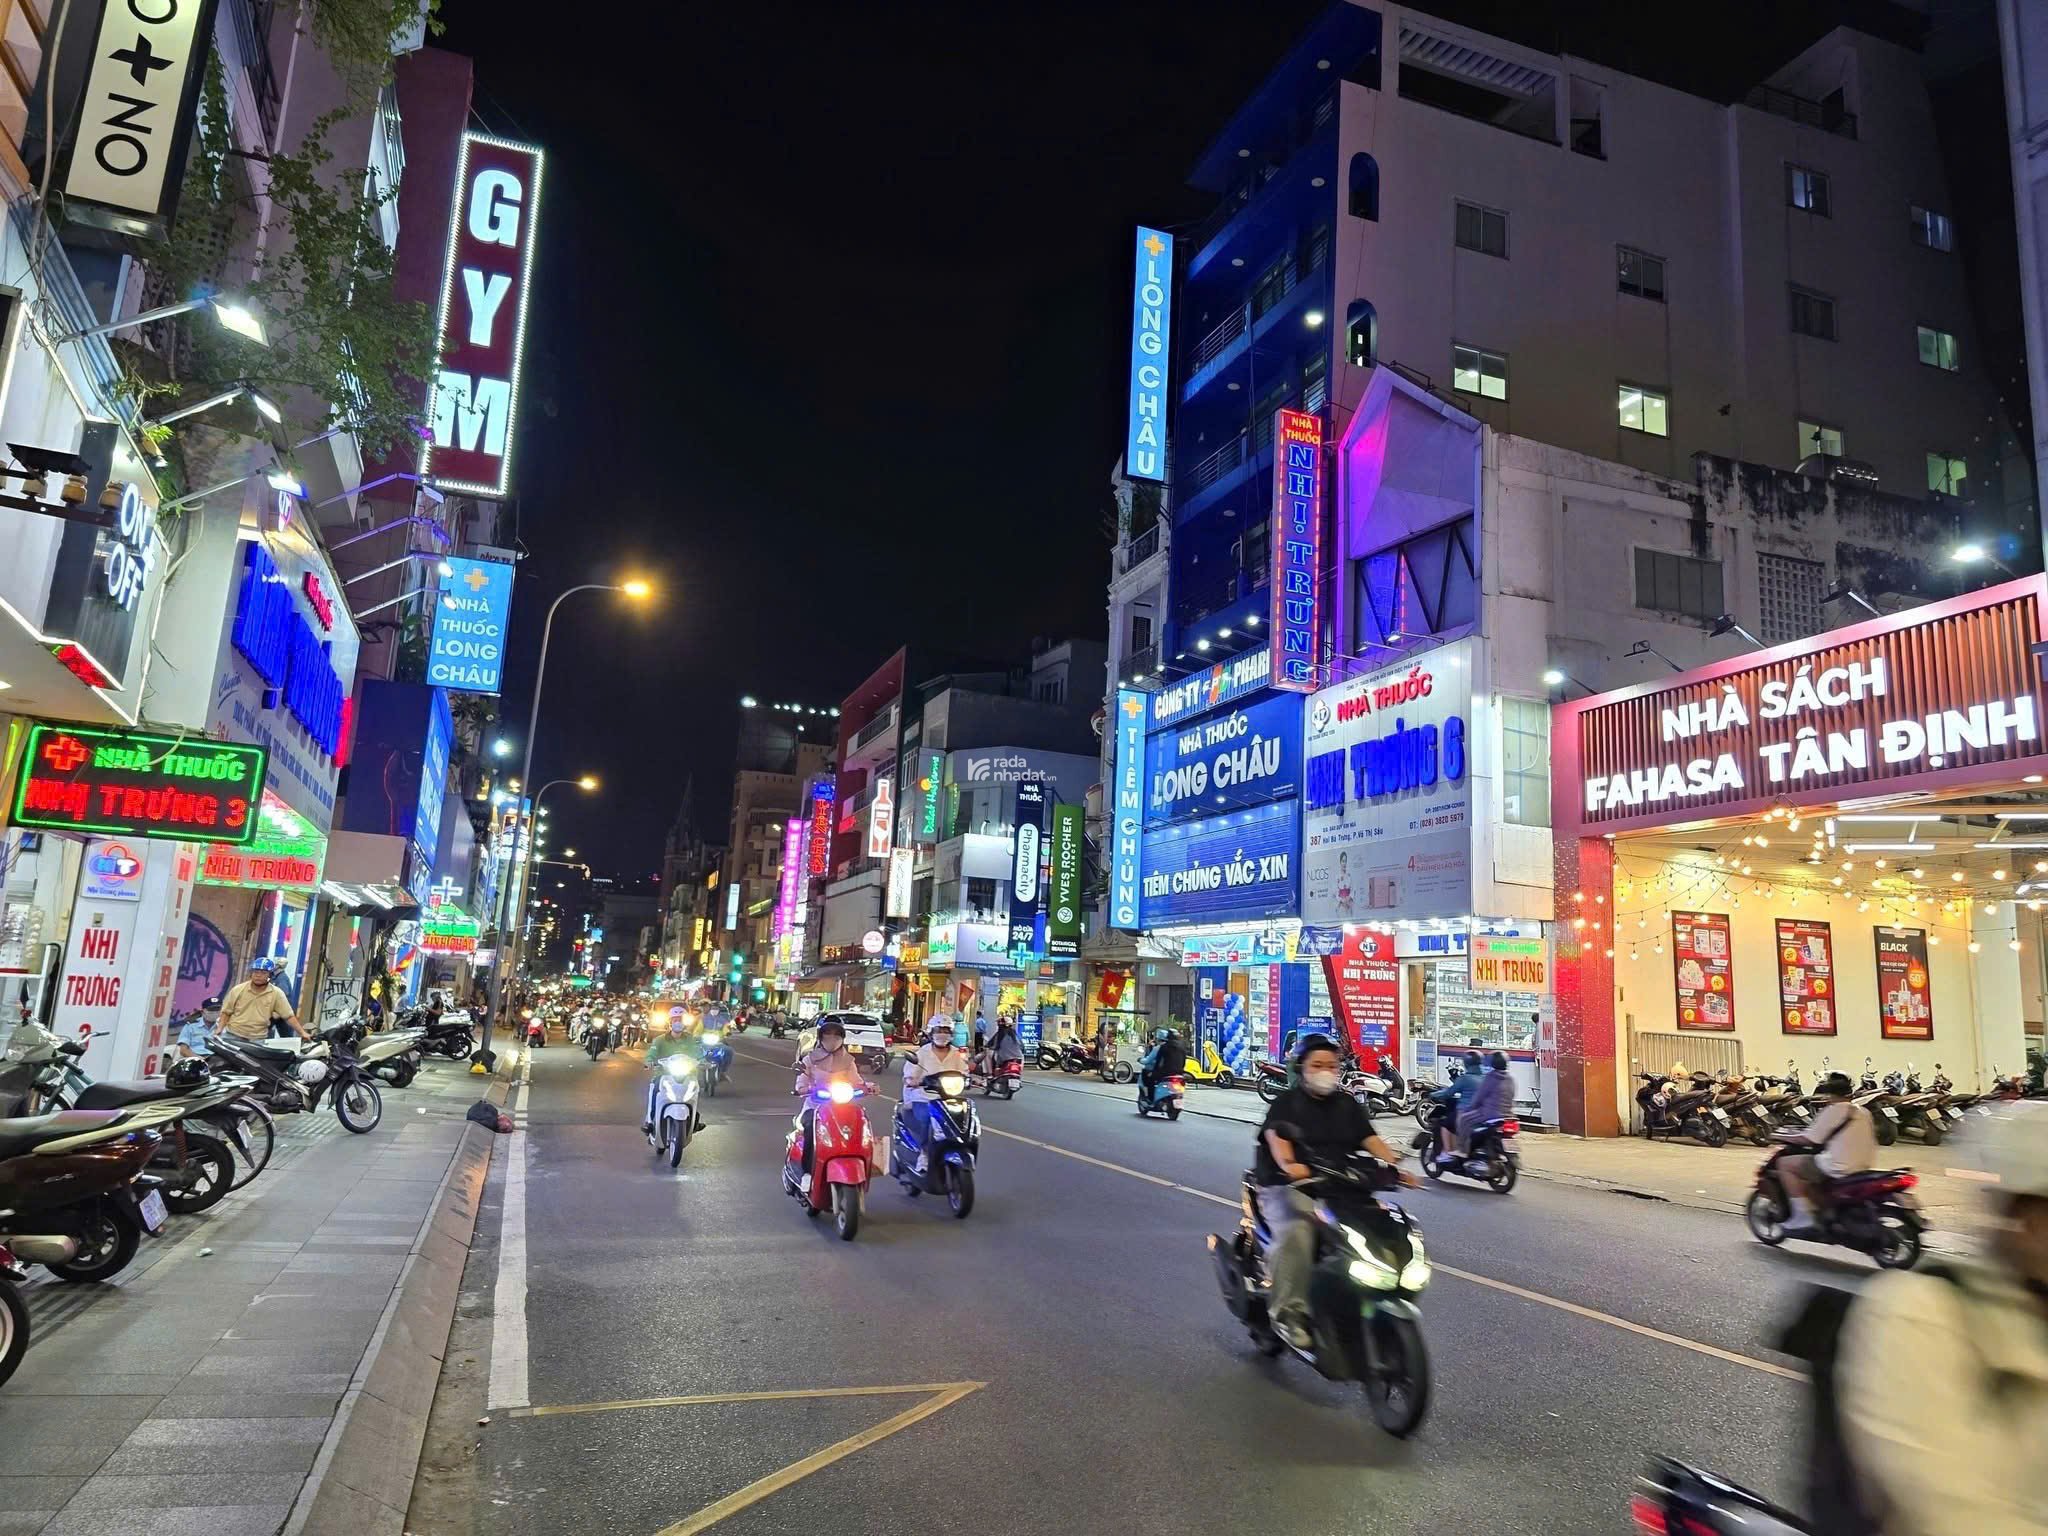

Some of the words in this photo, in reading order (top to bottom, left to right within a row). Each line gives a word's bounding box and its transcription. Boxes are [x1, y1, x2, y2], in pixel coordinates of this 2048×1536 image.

[433, 168, 524, 457] GYM
[1137, 260, 1165, 355] LONG
[1135, 365, 1162, 476] CHÂU
[1286, 428, 1321, 446] THUỐC
[1291, 414, 1314, 431] NHÀ
[120, 482, 151, 547] ON
[107, 543, 145, 613] OFF
[454, 597, 491, 614] NHÀ
[441, 618, 499, 637] THUỐC
[435, 638, 498, 661] LONG
[431, 663, 497, 686] CHÂU
[1155, 688, 1183, 720] CÔNG
[1186, 679, 1200, 708] TY
[1337, 688, 1372, 722] NHÀ
[1372, 666, 1433, 710] THUỐC
[1662, 686, 1749, 743] NHÀ
[1760, 664, 1888, 719] SÁCH
[1178, 726, 1203, 756] NHÀ
[1206, 710, 1248, 747] THUỐC
[1443, 715, 1465, 781] 6
[162, 753, 247, 782] THUỐC
[1121, 727, 1139, 810] TIÊM
[1585, 752, 1745, 812] FAHASA
[1760, 728, 1867, 783] TÂN
[1880, 695, 2037, 768] ĐỊNH
[1152, 761, 1208, 807] LONG
[1213, 734, 1281, 789] CHÂU
[1019, 793, 1042, 802] THUỐC
[1024, 784, 1038, 792] NHÀ
[223, 798, 248, 828] 3
[1420, 818, 1434, 829] (028)
[1435, 814, 1449, 826] 3820
[1061, 816, 1073, 869] ROCHER
[1310, 835, 1322, 846] 387
[1116, 817, 1138, 924] CHỦNG
[1143, 870, 1169, 898] TIÊM
[1172, 860, 1221, 894] CHỦNG
[1225, 848, 1256, 887] VẮC
[1259, 854, 1288, 882] XIN
[1407, 855, 1416, 872] 4
[1060, 871, 1071, 904] YVES
[80, 928, 120, 966] NHỊ
[1012, 931, 1034, 941] 24/7
[1418, 934, 1449, 954] NHỊ
[1880, 942, 1908, 952] BLACK
[1343, 968, 1360, 981] NHỊ
[1363, 967, 1396, 981] TRƯNG
[1476, 958, 1498, 985] NHỊ
[1502, 956, 1544, 983] TRƯNG
[64, 972, 121, 1008] TRƯNG
